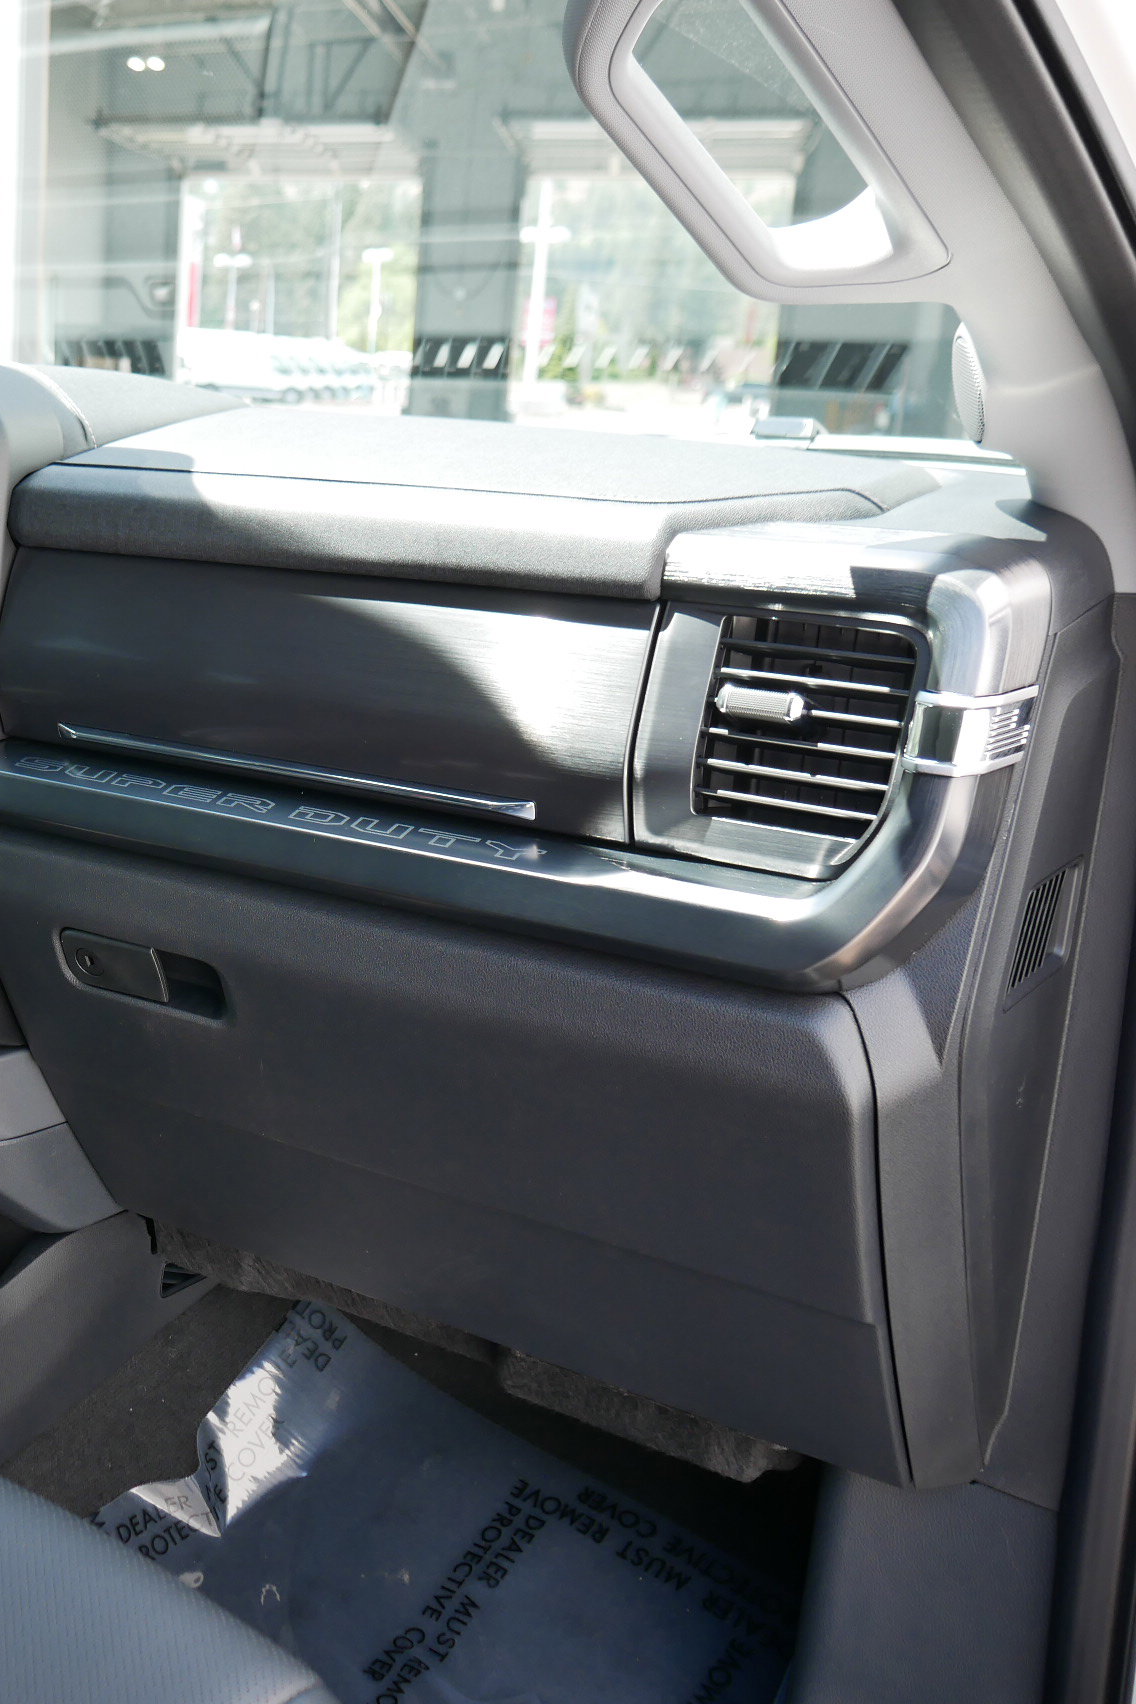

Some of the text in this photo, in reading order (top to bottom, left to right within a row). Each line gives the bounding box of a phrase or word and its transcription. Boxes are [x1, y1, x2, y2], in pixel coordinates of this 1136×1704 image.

[14, 756, 548, 861] SUPER DUTY
[510, 1478, 610, 1543] REMOVE
[576, 1486, 658, 1538] COVER
[477, 1514, 547, 1589] DEALER
[616, 1539, 692, 1592] MUST
[363, 1500, 522, 1682] PROTECTIVE COVER
[428, 1594, 481, 1663] MUST
